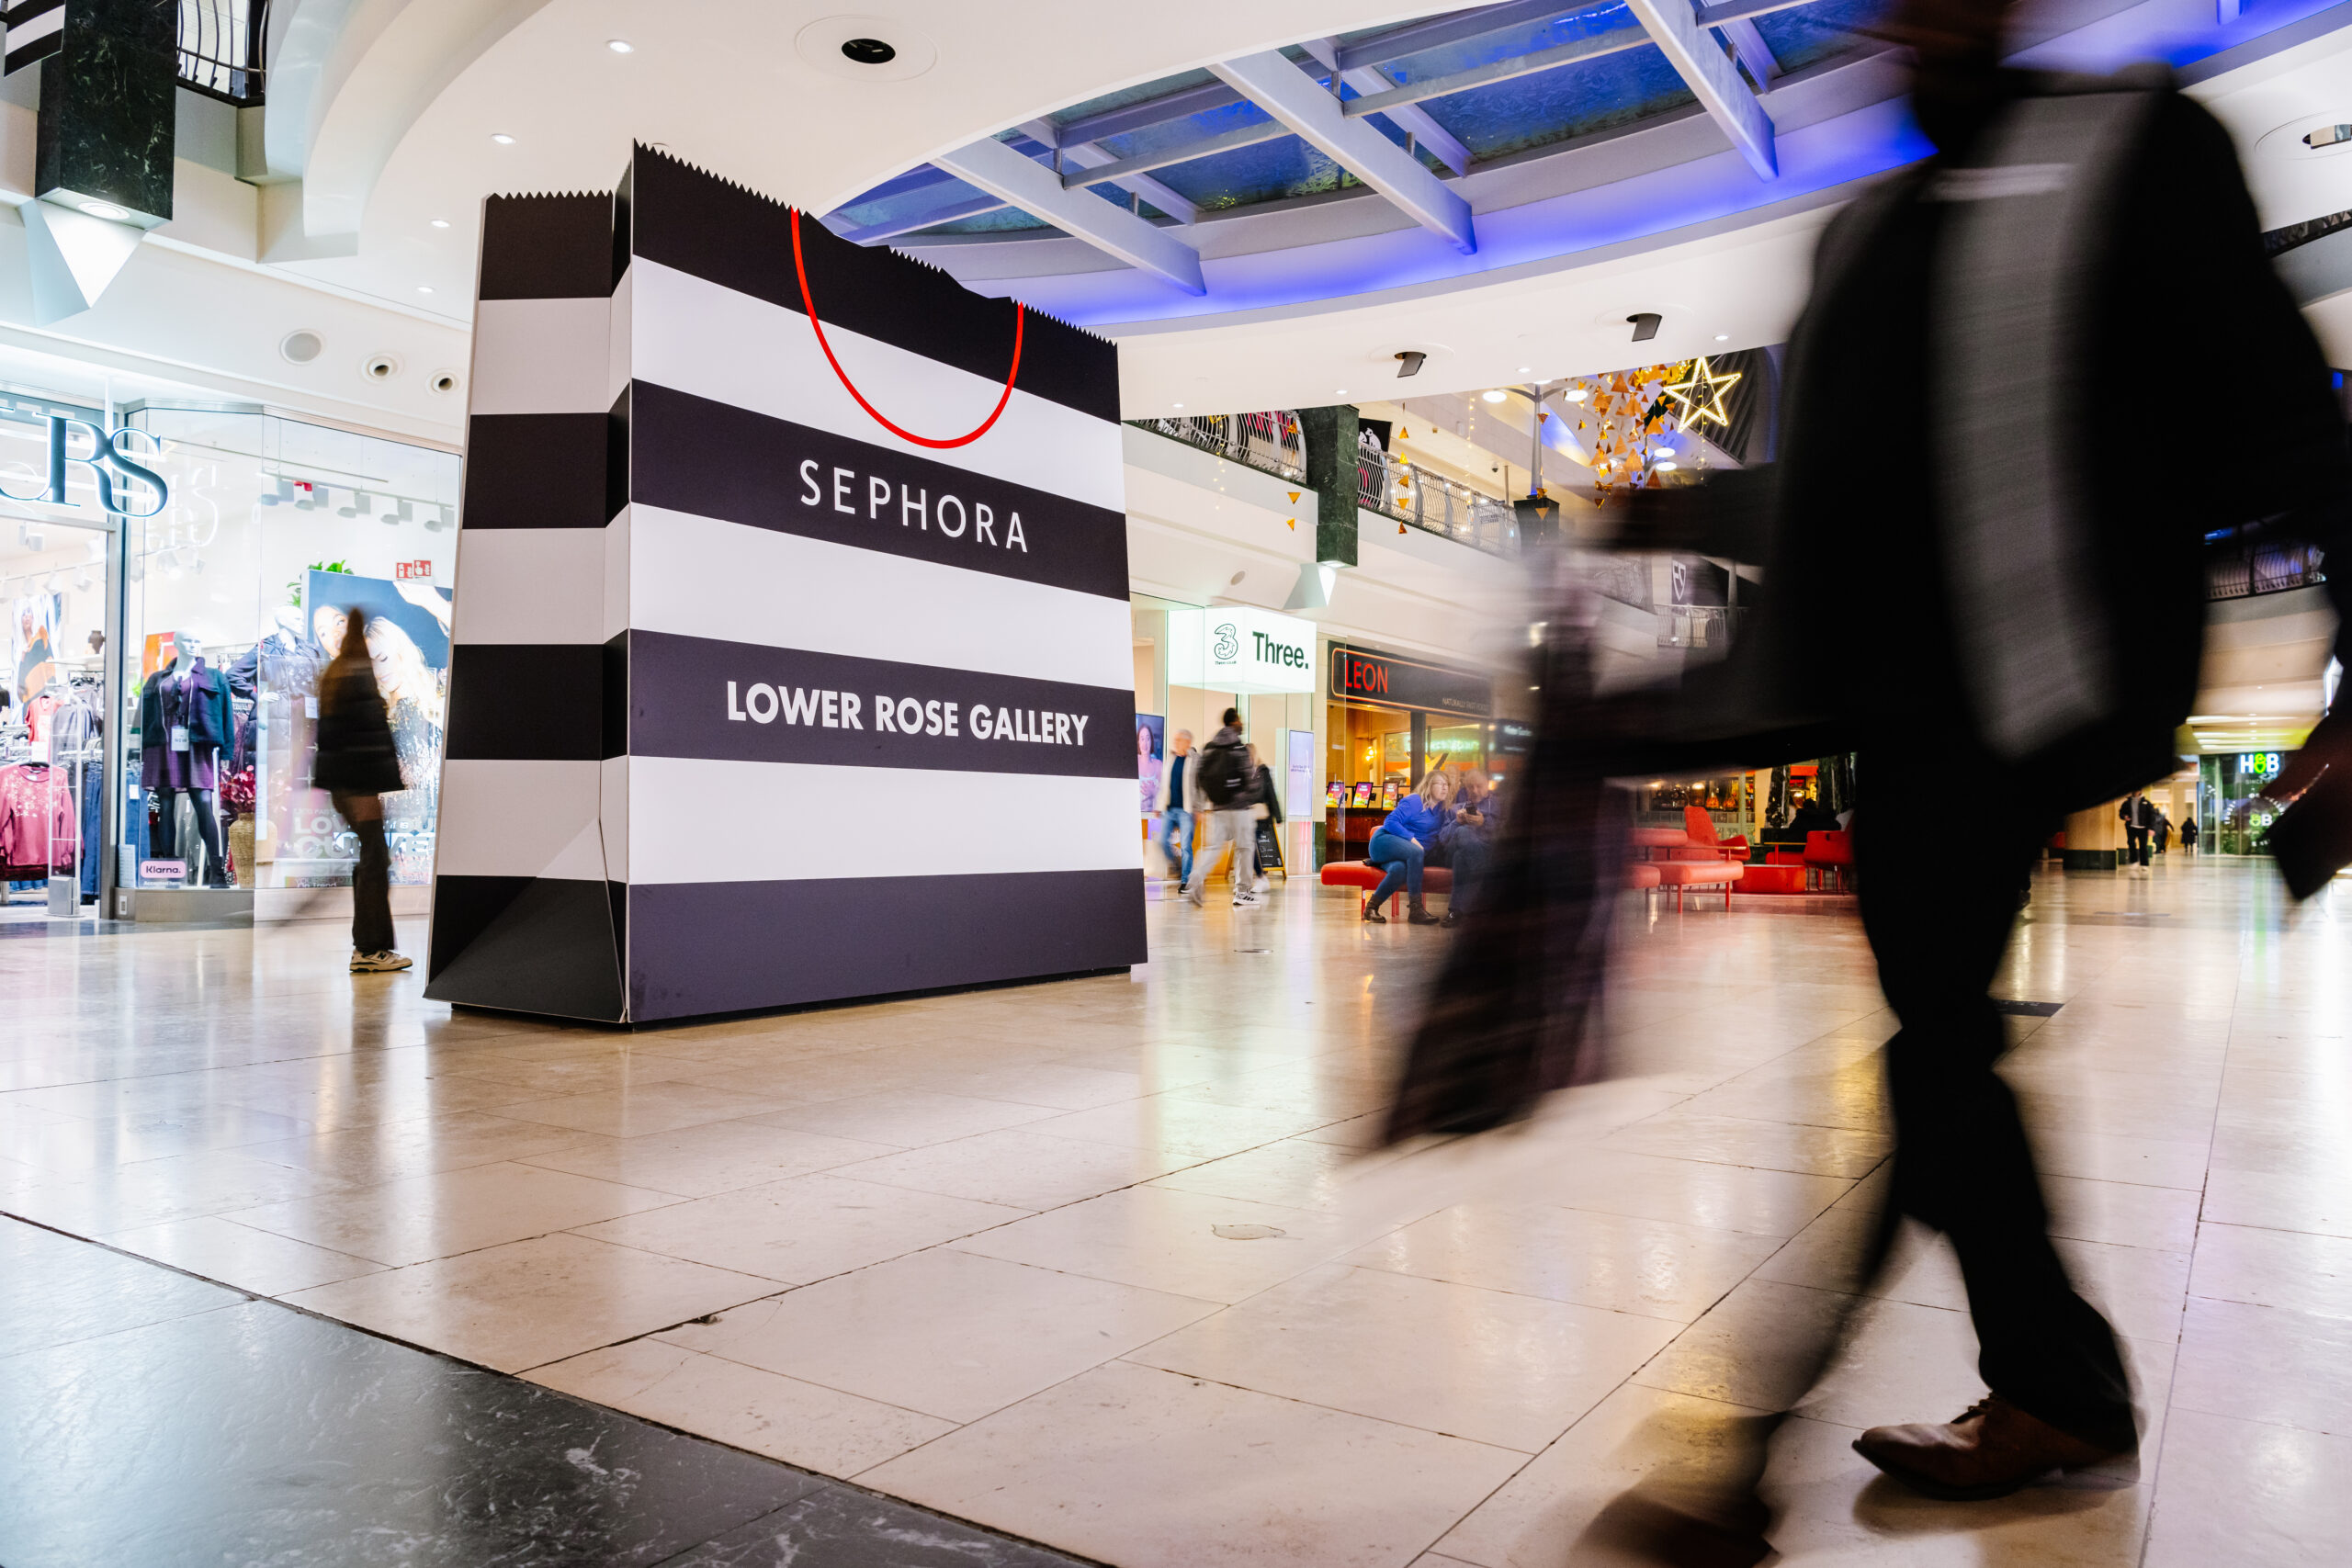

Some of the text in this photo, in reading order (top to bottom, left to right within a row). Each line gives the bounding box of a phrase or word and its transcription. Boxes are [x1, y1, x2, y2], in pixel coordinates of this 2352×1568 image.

[799, 459, 1028, 554] SEPHORA
[1252, 631, 1309, 670] Three.
[1346, 659, 1388, 694] LEON
[726, 680, 1090, 747] LOWER ROSE GALLERY
[293, 816, 349, 834] LOV
[145, 865, 181, 874] Klarna.
